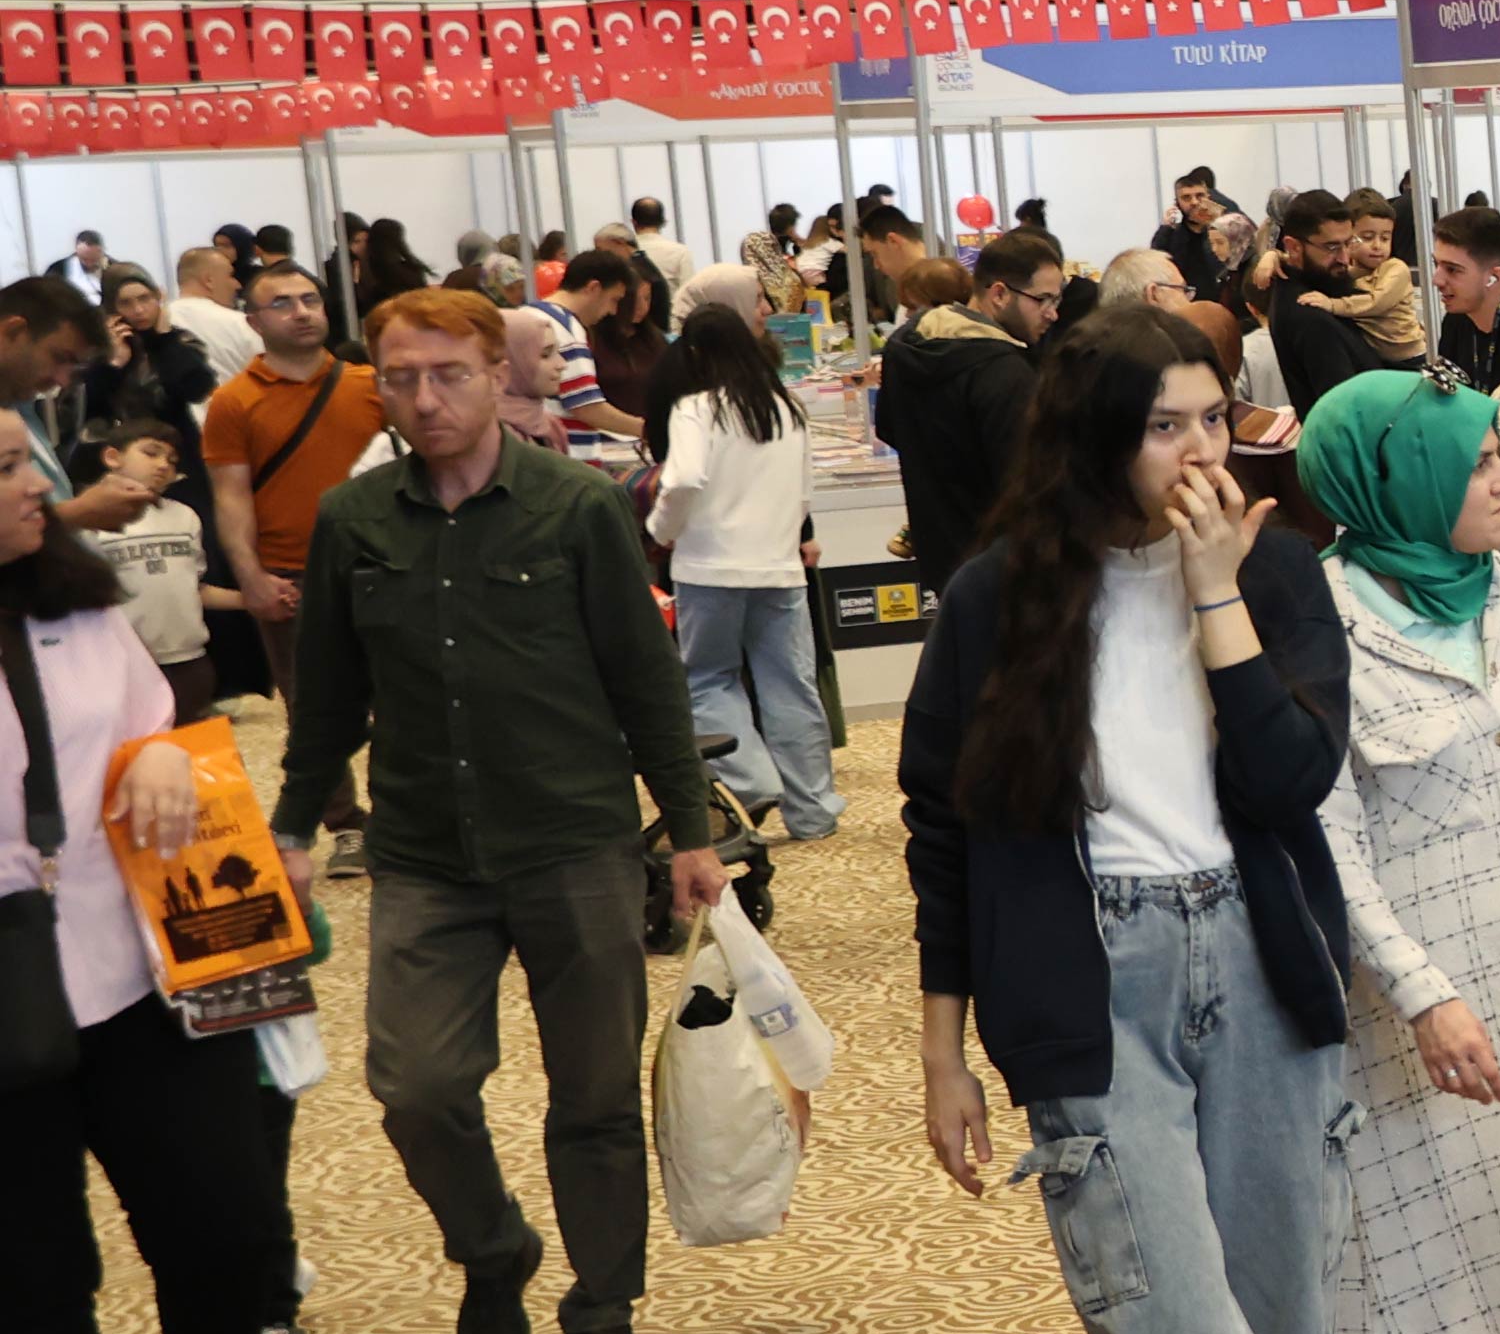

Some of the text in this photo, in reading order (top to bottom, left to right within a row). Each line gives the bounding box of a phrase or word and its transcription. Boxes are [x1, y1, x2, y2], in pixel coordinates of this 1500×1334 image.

[1438, 0, 1477, 32] ORENDA
[1173, 39, 1268, 66] TULU KİTAP
